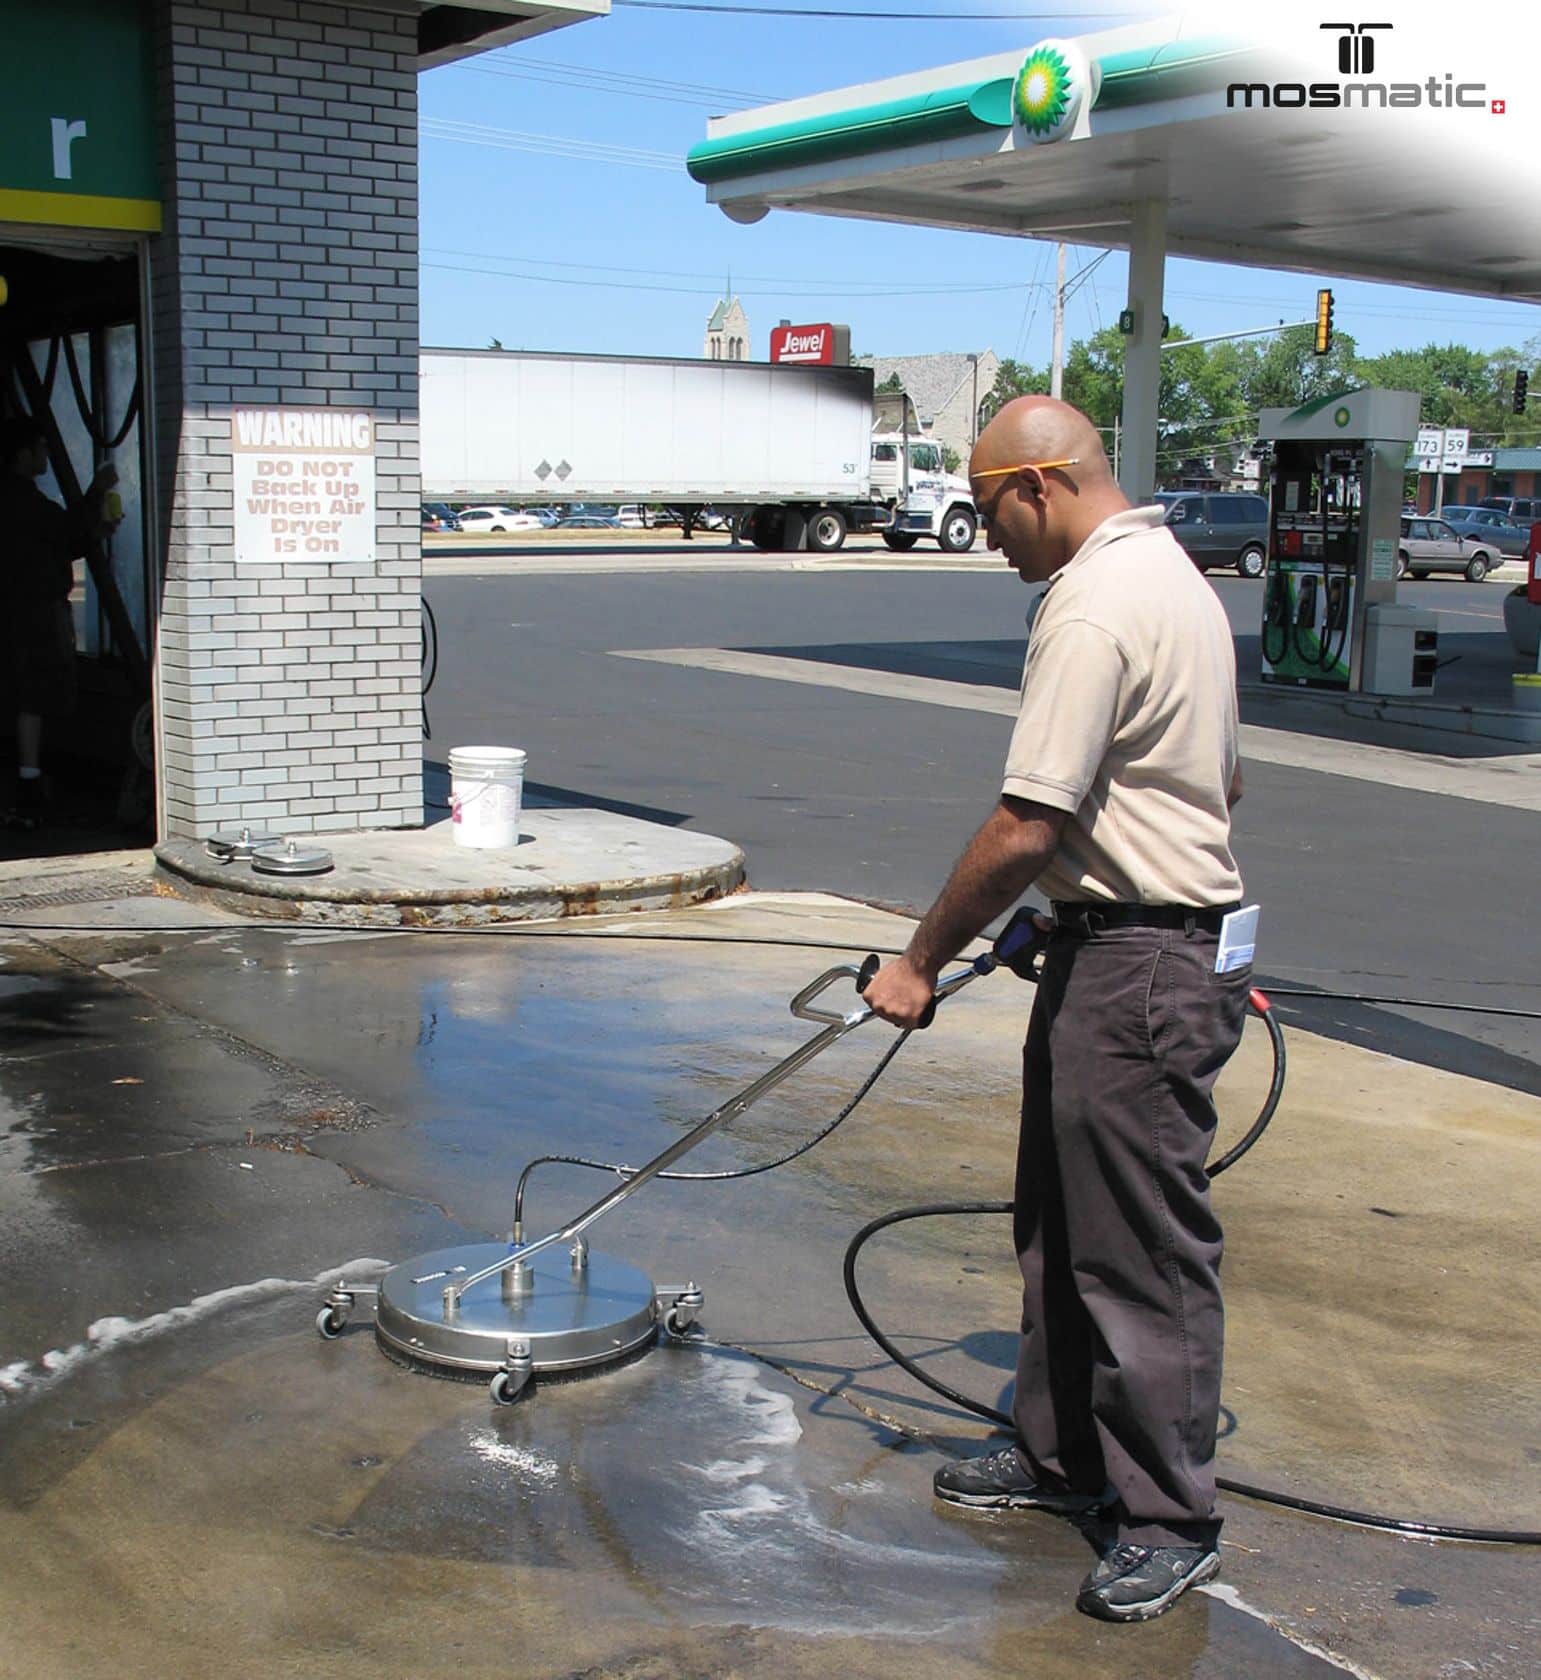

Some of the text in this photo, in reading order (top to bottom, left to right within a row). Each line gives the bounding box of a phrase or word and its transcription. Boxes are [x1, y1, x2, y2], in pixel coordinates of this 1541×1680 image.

[50, 117, 87, 179] r
[780, 328, 825, 353] Jewel
[236, 411, 370, 449] WARNING
[1417, 440, 1438, 453] 173
[1447, 440, 1464, 452] 59
[257, 461, 353, 477] DO NOT
[251, 480, 359, 499] Back Up
[246, 499, 365, 514] When Air
[271, 518, 342, 536] Dryer
[274, 537, 339, 552] Is On
